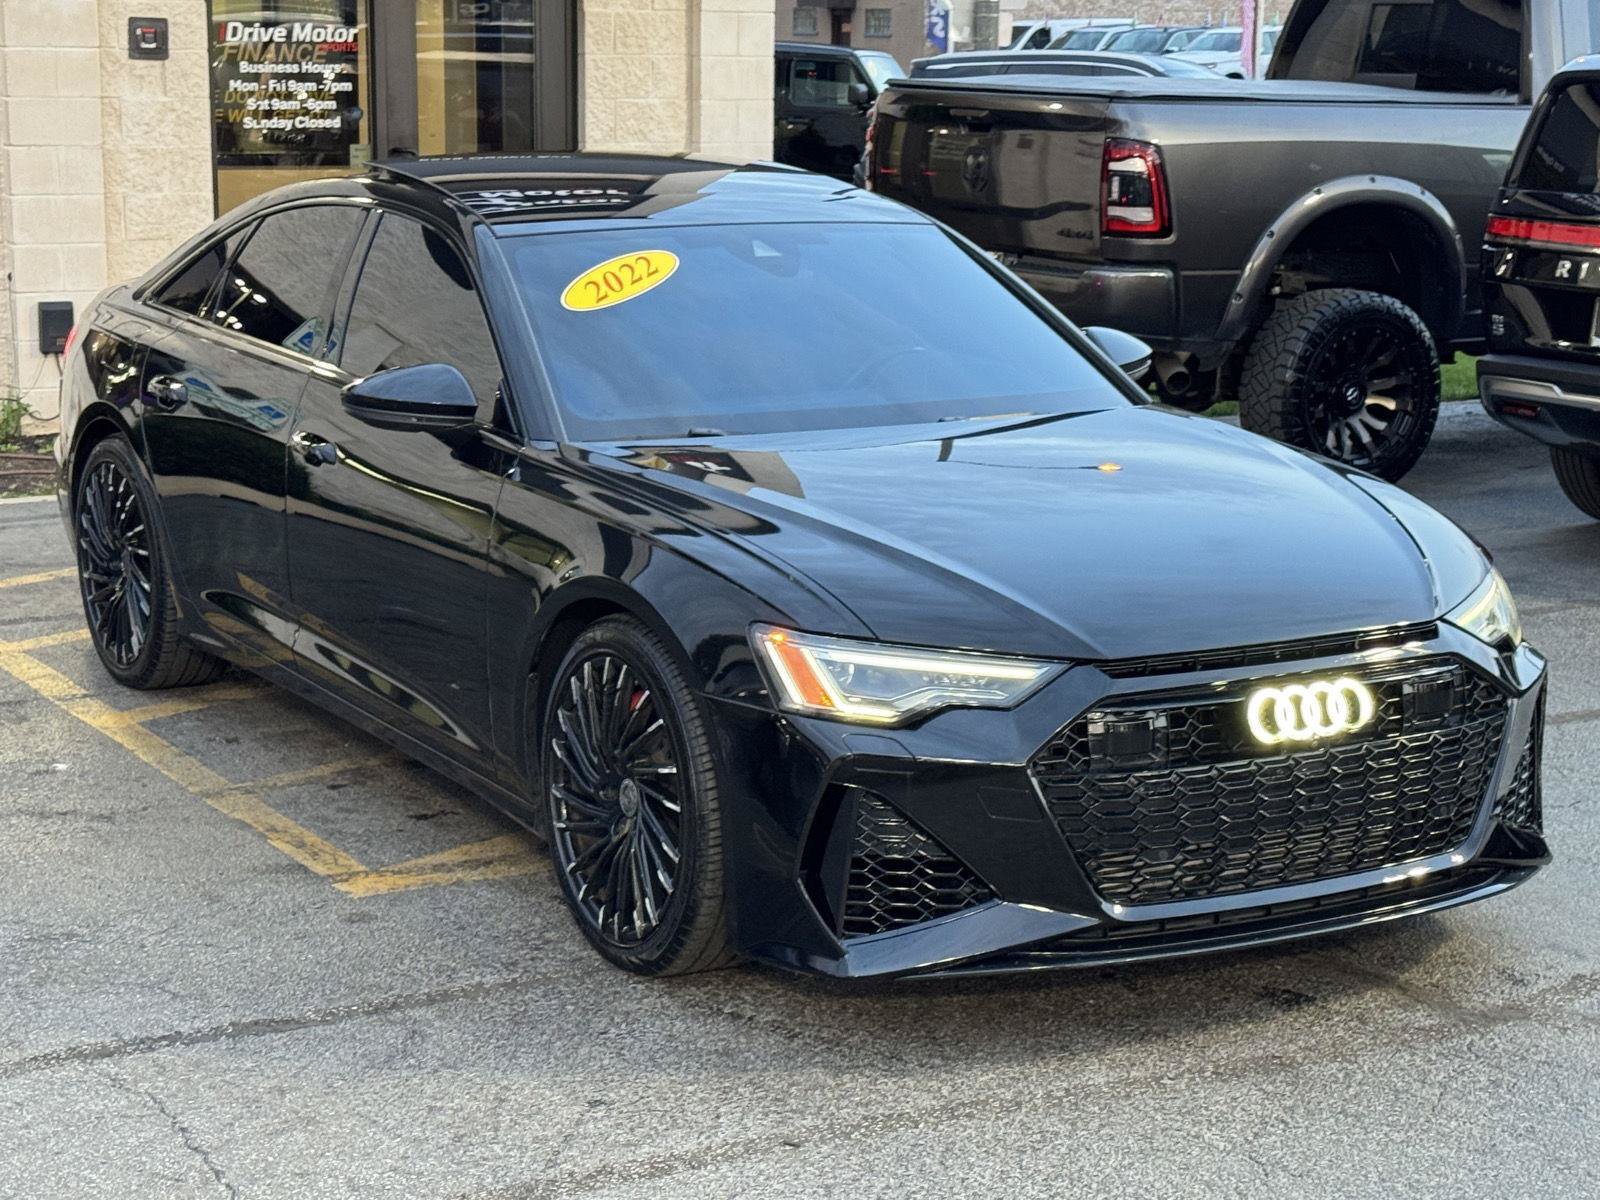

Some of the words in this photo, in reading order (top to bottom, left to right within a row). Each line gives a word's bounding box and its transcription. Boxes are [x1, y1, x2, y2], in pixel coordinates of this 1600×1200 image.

[291, 22, 359, 43] Motor
[239, 61, 300, 73] Business
[301, 61, 341, 74] Hours
[229, 79, 259, 92] Mon
[242, 116, 294, 130] Sunday
[295, 116, 342, 128] Closed
[584, 256, 659, 303] 2022
